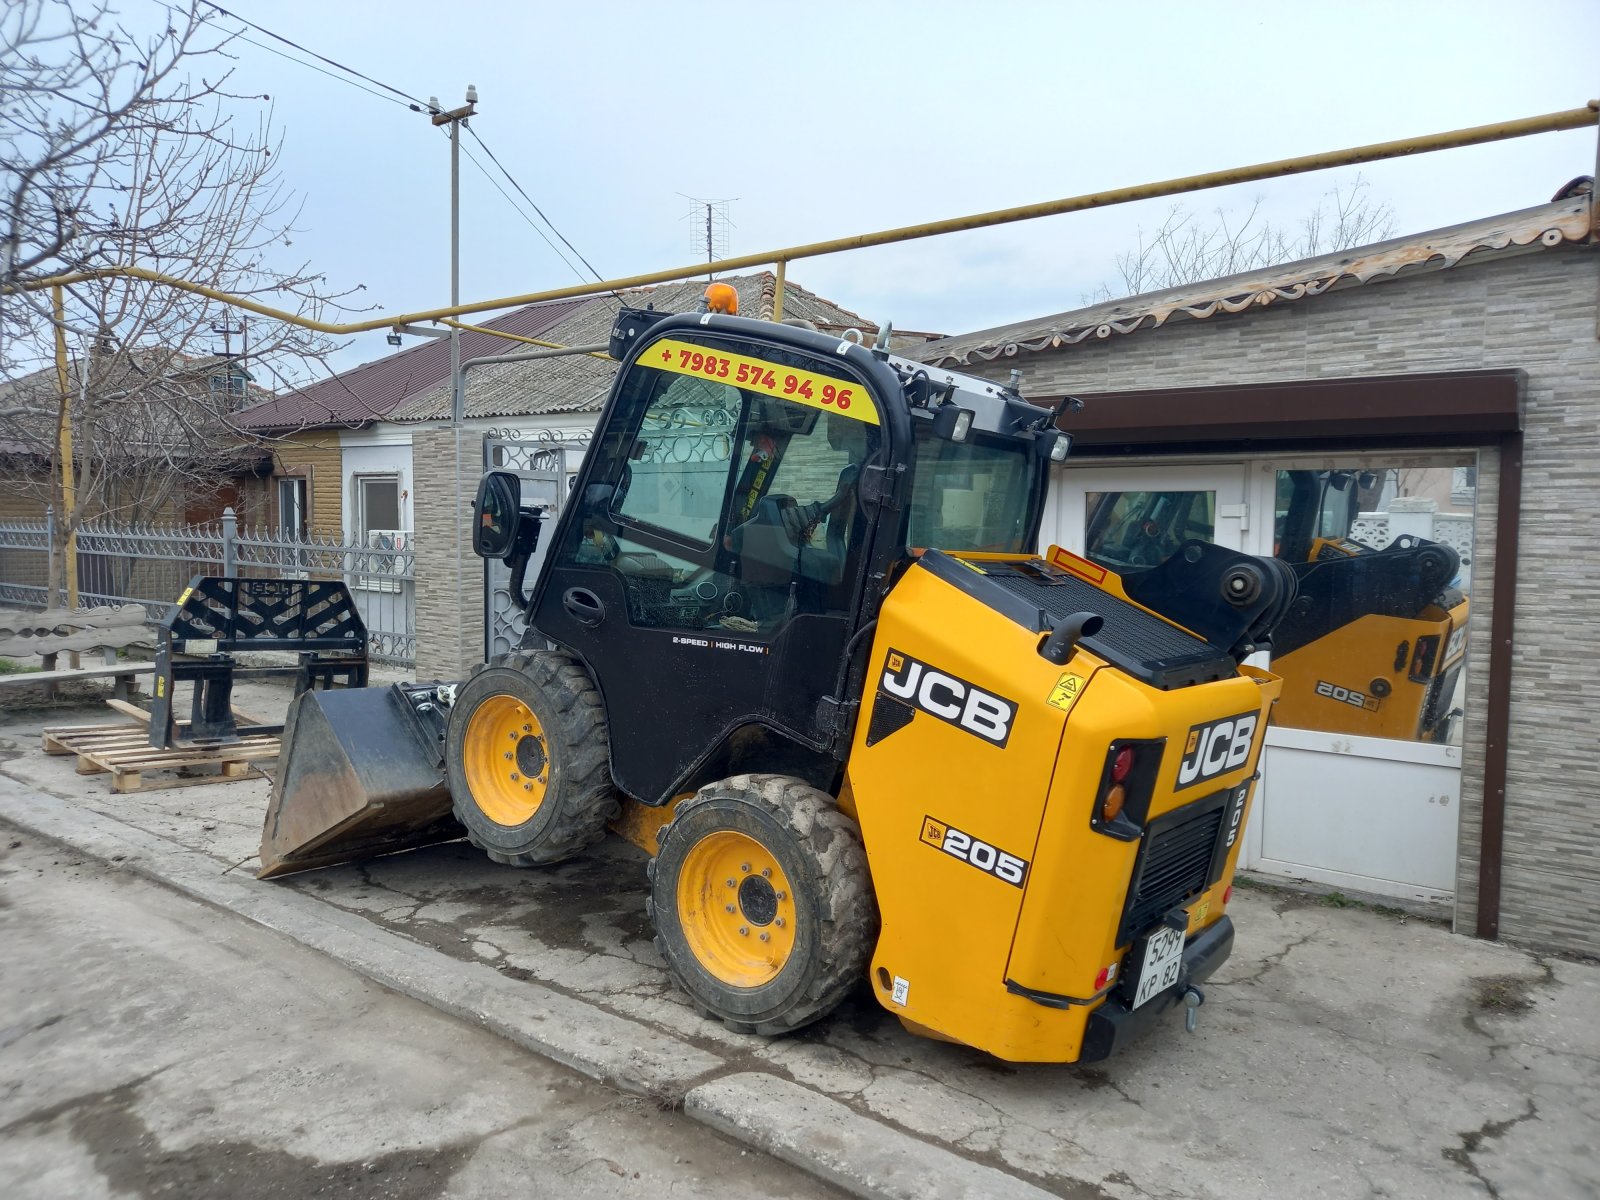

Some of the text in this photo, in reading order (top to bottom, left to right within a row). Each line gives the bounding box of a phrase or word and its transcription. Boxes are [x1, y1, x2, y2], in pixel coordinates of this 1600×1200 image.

[679, 350, 731, 378] 7983
[735, 363, 776, 390] 574
[783, 374, 814, 400] 94
[820, 385, 853, 410] 96
[672, 637, 764, 654] 2-SPEED HIGH FLOW
[883, 662, 1011, 741] JCB
[1179, 715, 1257, 785] JCB
[1226, 789, 1246, 847] 205
[942, 829, 1025, 884] 205
[1162, 962, 1177, 986] 82
